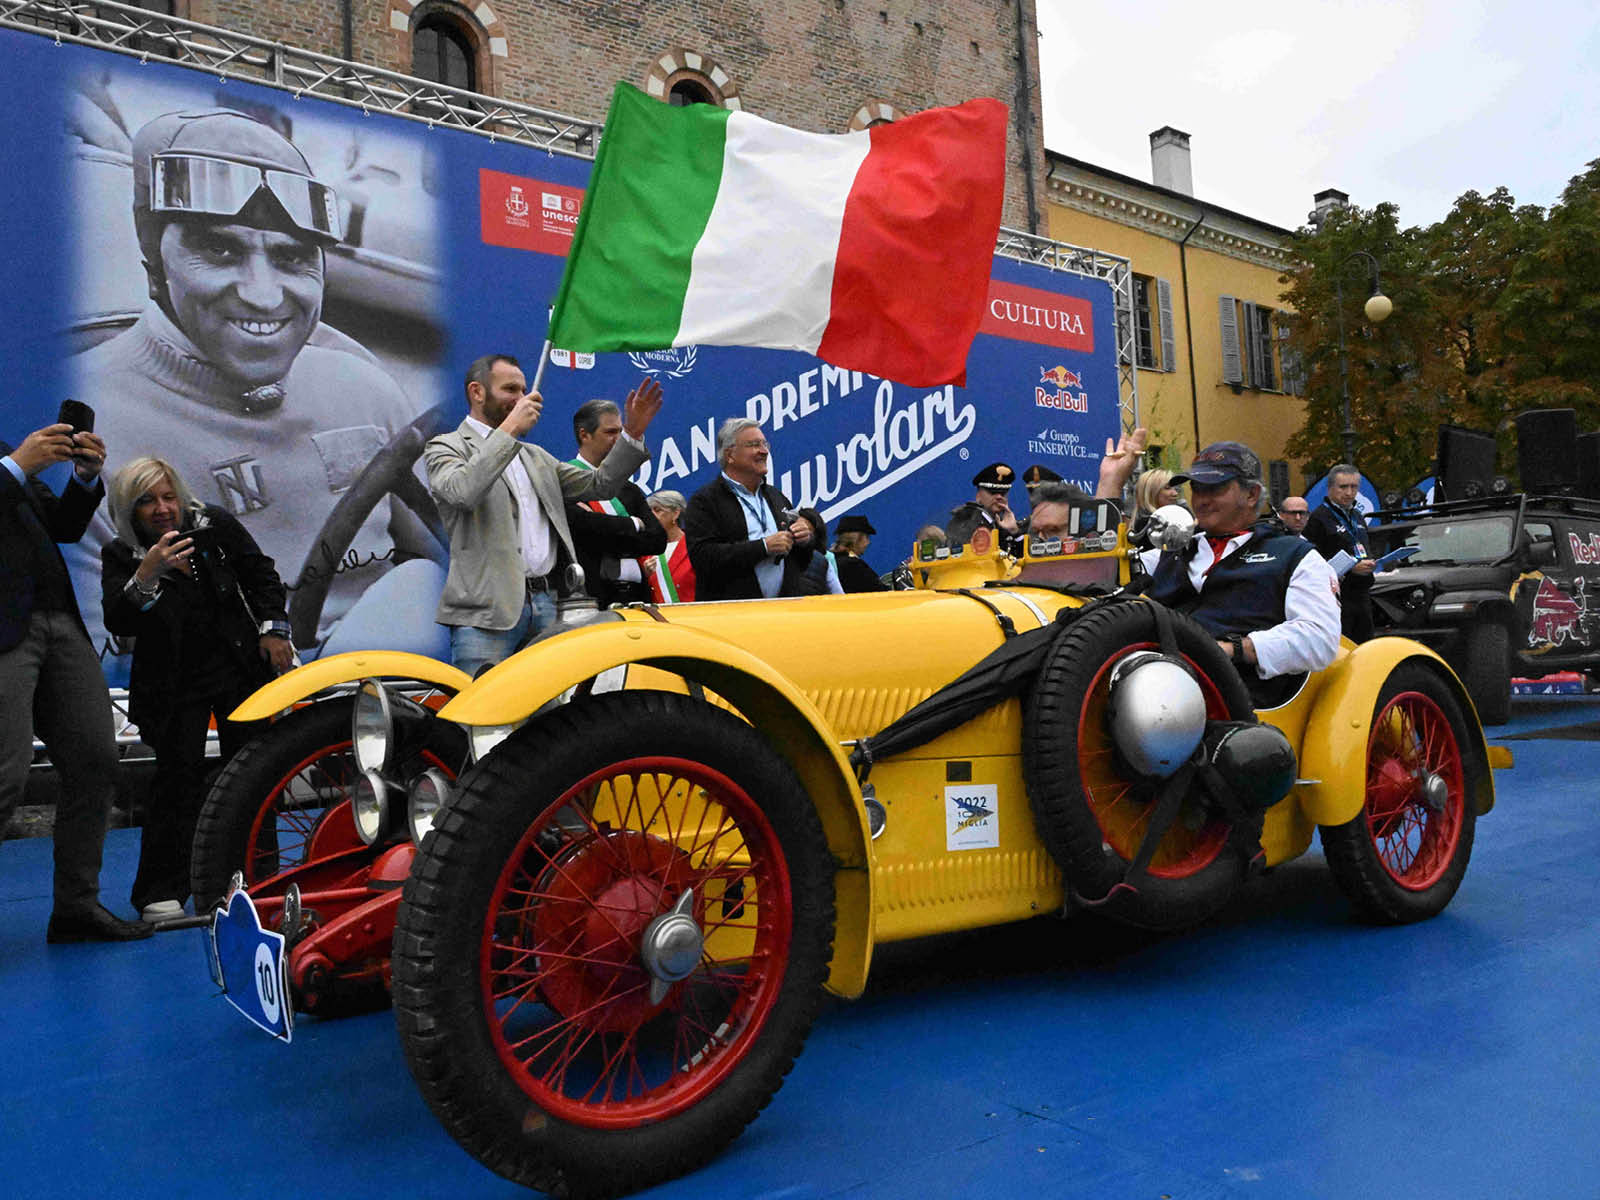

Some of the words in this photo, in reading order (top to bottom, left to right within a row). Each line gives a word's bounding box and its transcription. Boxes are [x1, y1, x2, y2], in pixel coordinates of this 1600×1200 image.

[990, 299, 1086, 335] CULTURA
[1035, 387, 1062, 409] Red
[1063, 391, 1088, 413] Bull
[628, 416, 716, 497] RAN
[746, 363, 880, 431] PREMI
[1050, 429, 1080, 445] Gruppo
[958, 796, 987, 808] 2022
[958, 819, 988, 827] MIGLIA
[258, 961, 275, 1006] 10
